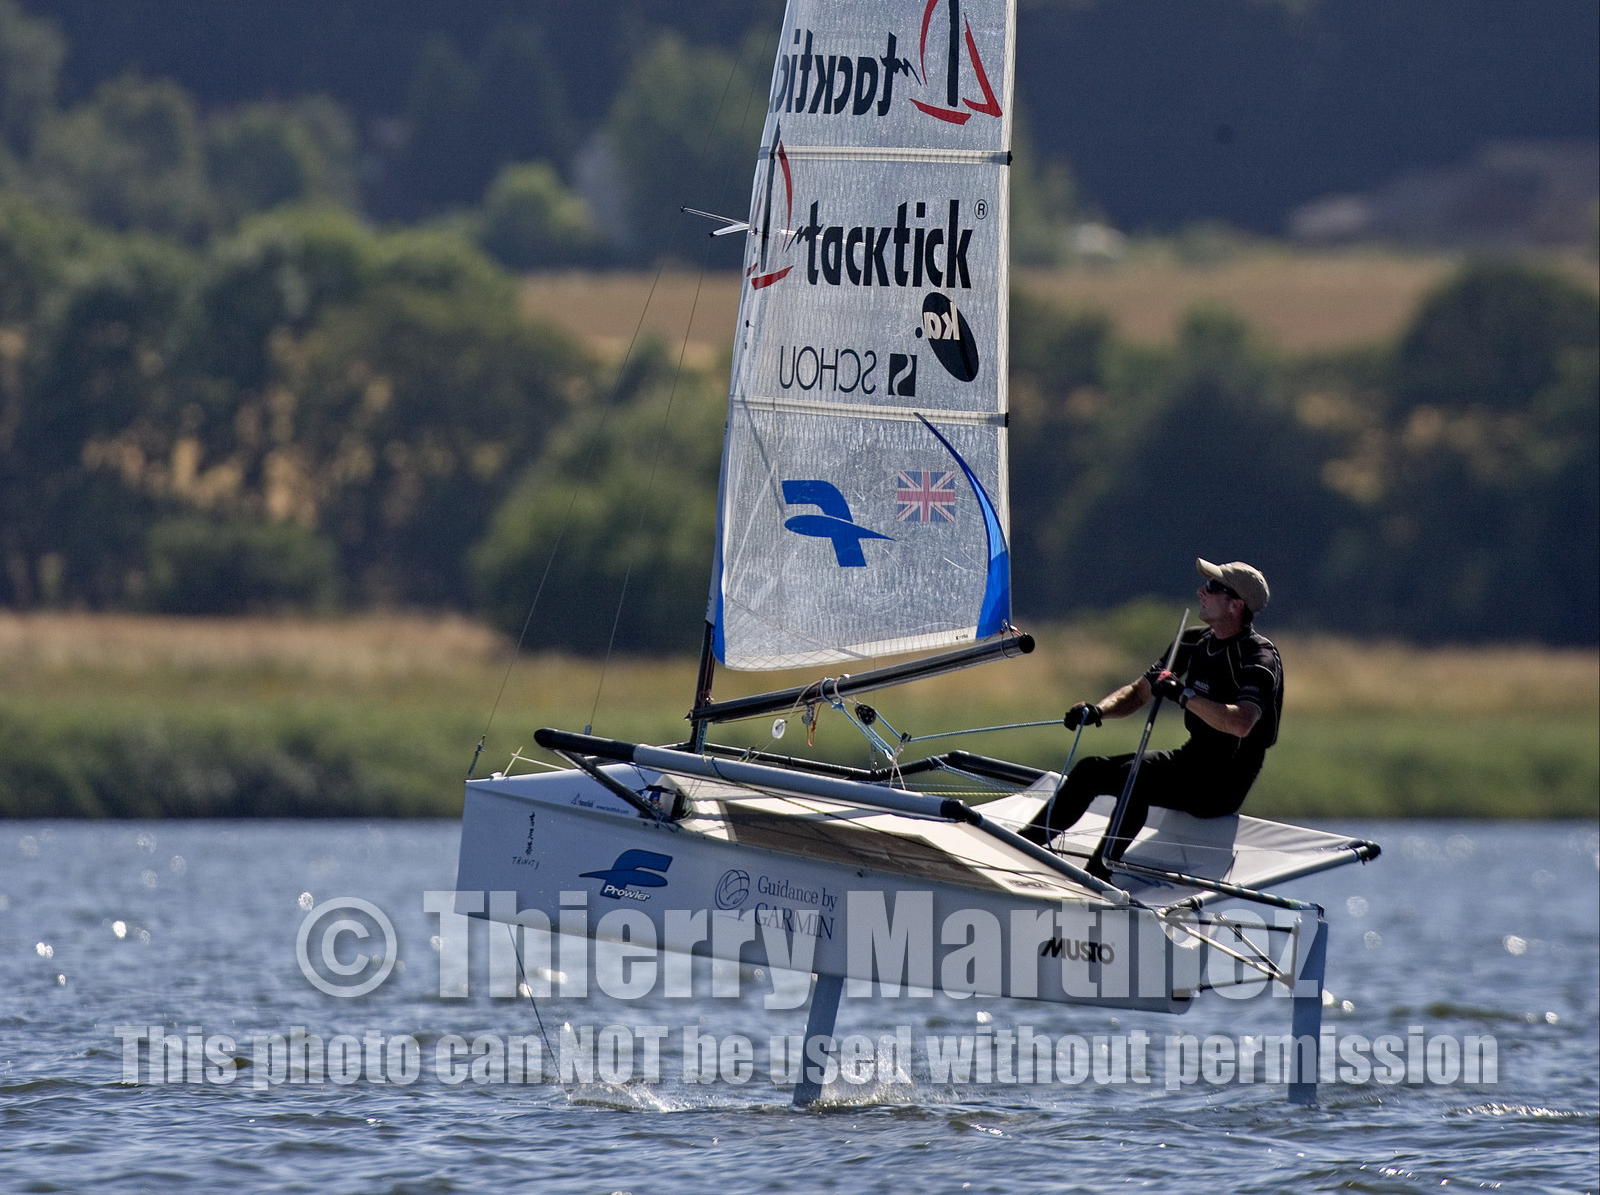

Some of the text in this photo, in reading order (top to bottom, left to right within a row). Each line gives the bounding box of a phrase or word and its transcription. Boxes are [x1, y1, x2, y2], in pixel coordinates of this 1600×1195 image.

[603, 884, 651, 903] Prowler
[757, 875, 838, 911] Guidance by
[754, 902, 835, 941] GARMIN
[1040, 936, 1115, 965] MUSTO
